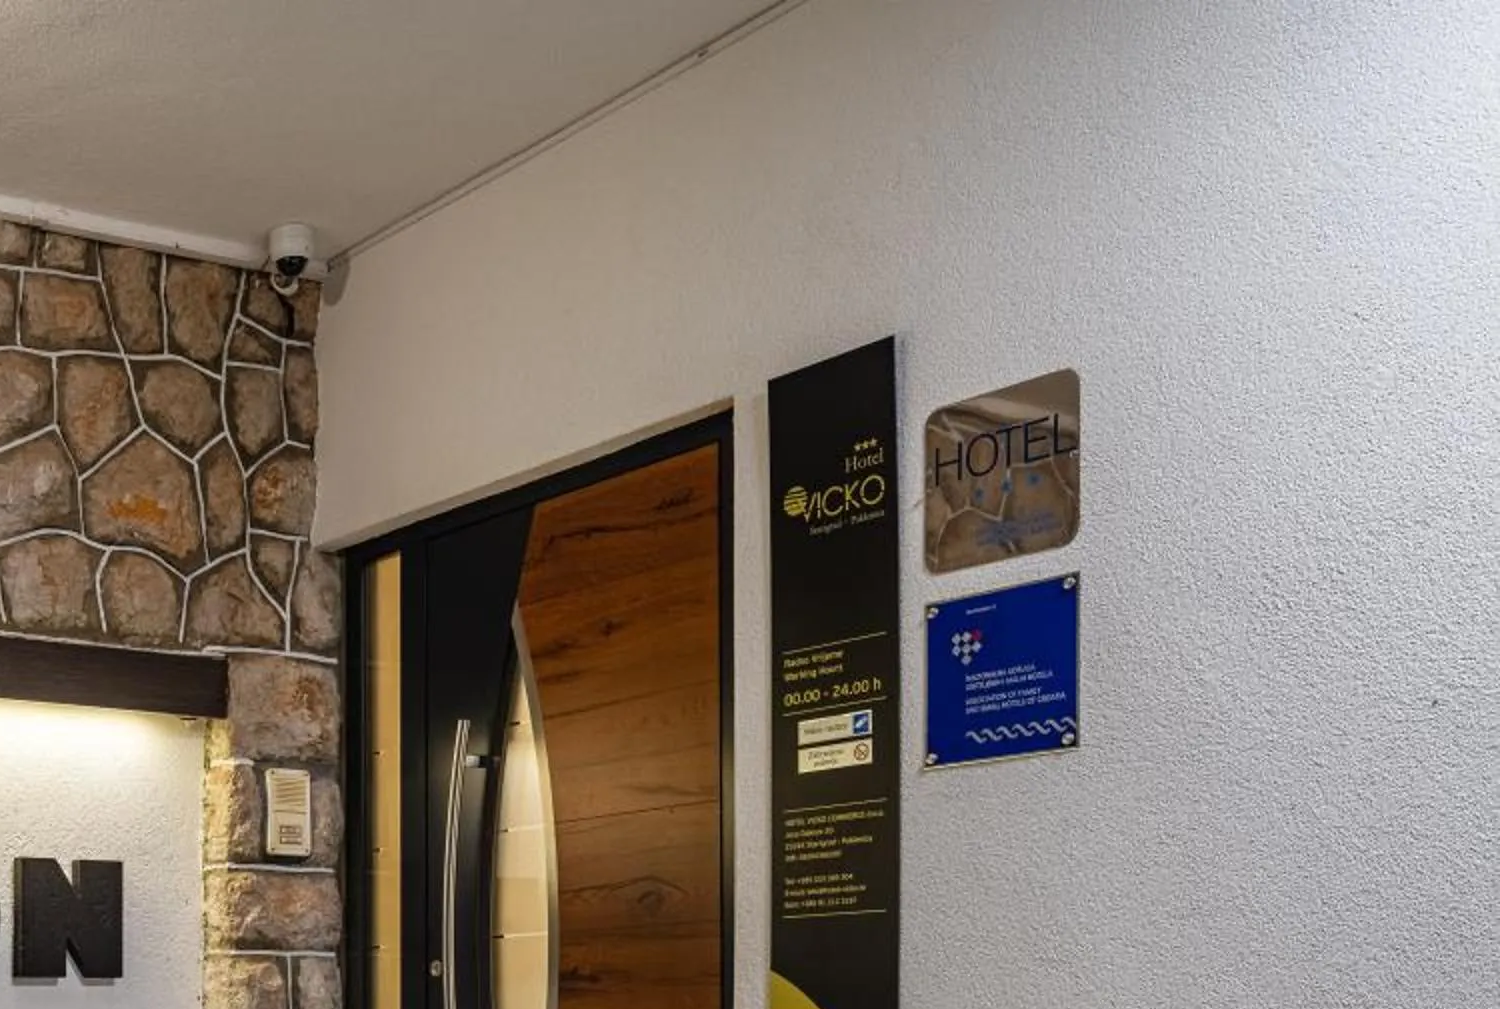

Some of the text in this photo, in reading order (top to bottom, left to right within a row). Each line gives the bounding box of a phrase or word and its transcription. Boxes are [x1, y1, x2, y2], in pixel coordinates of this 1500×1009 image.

[845, 448, 884, 473] Hotel
[935, 413, 1079, 487] HOTEL
[802, 474, 885, 523] VICKO
[784, 689, 821, 707] 00.00
[832, 679, 870, 698] 24.00
[873, 677, 882, 691] h
